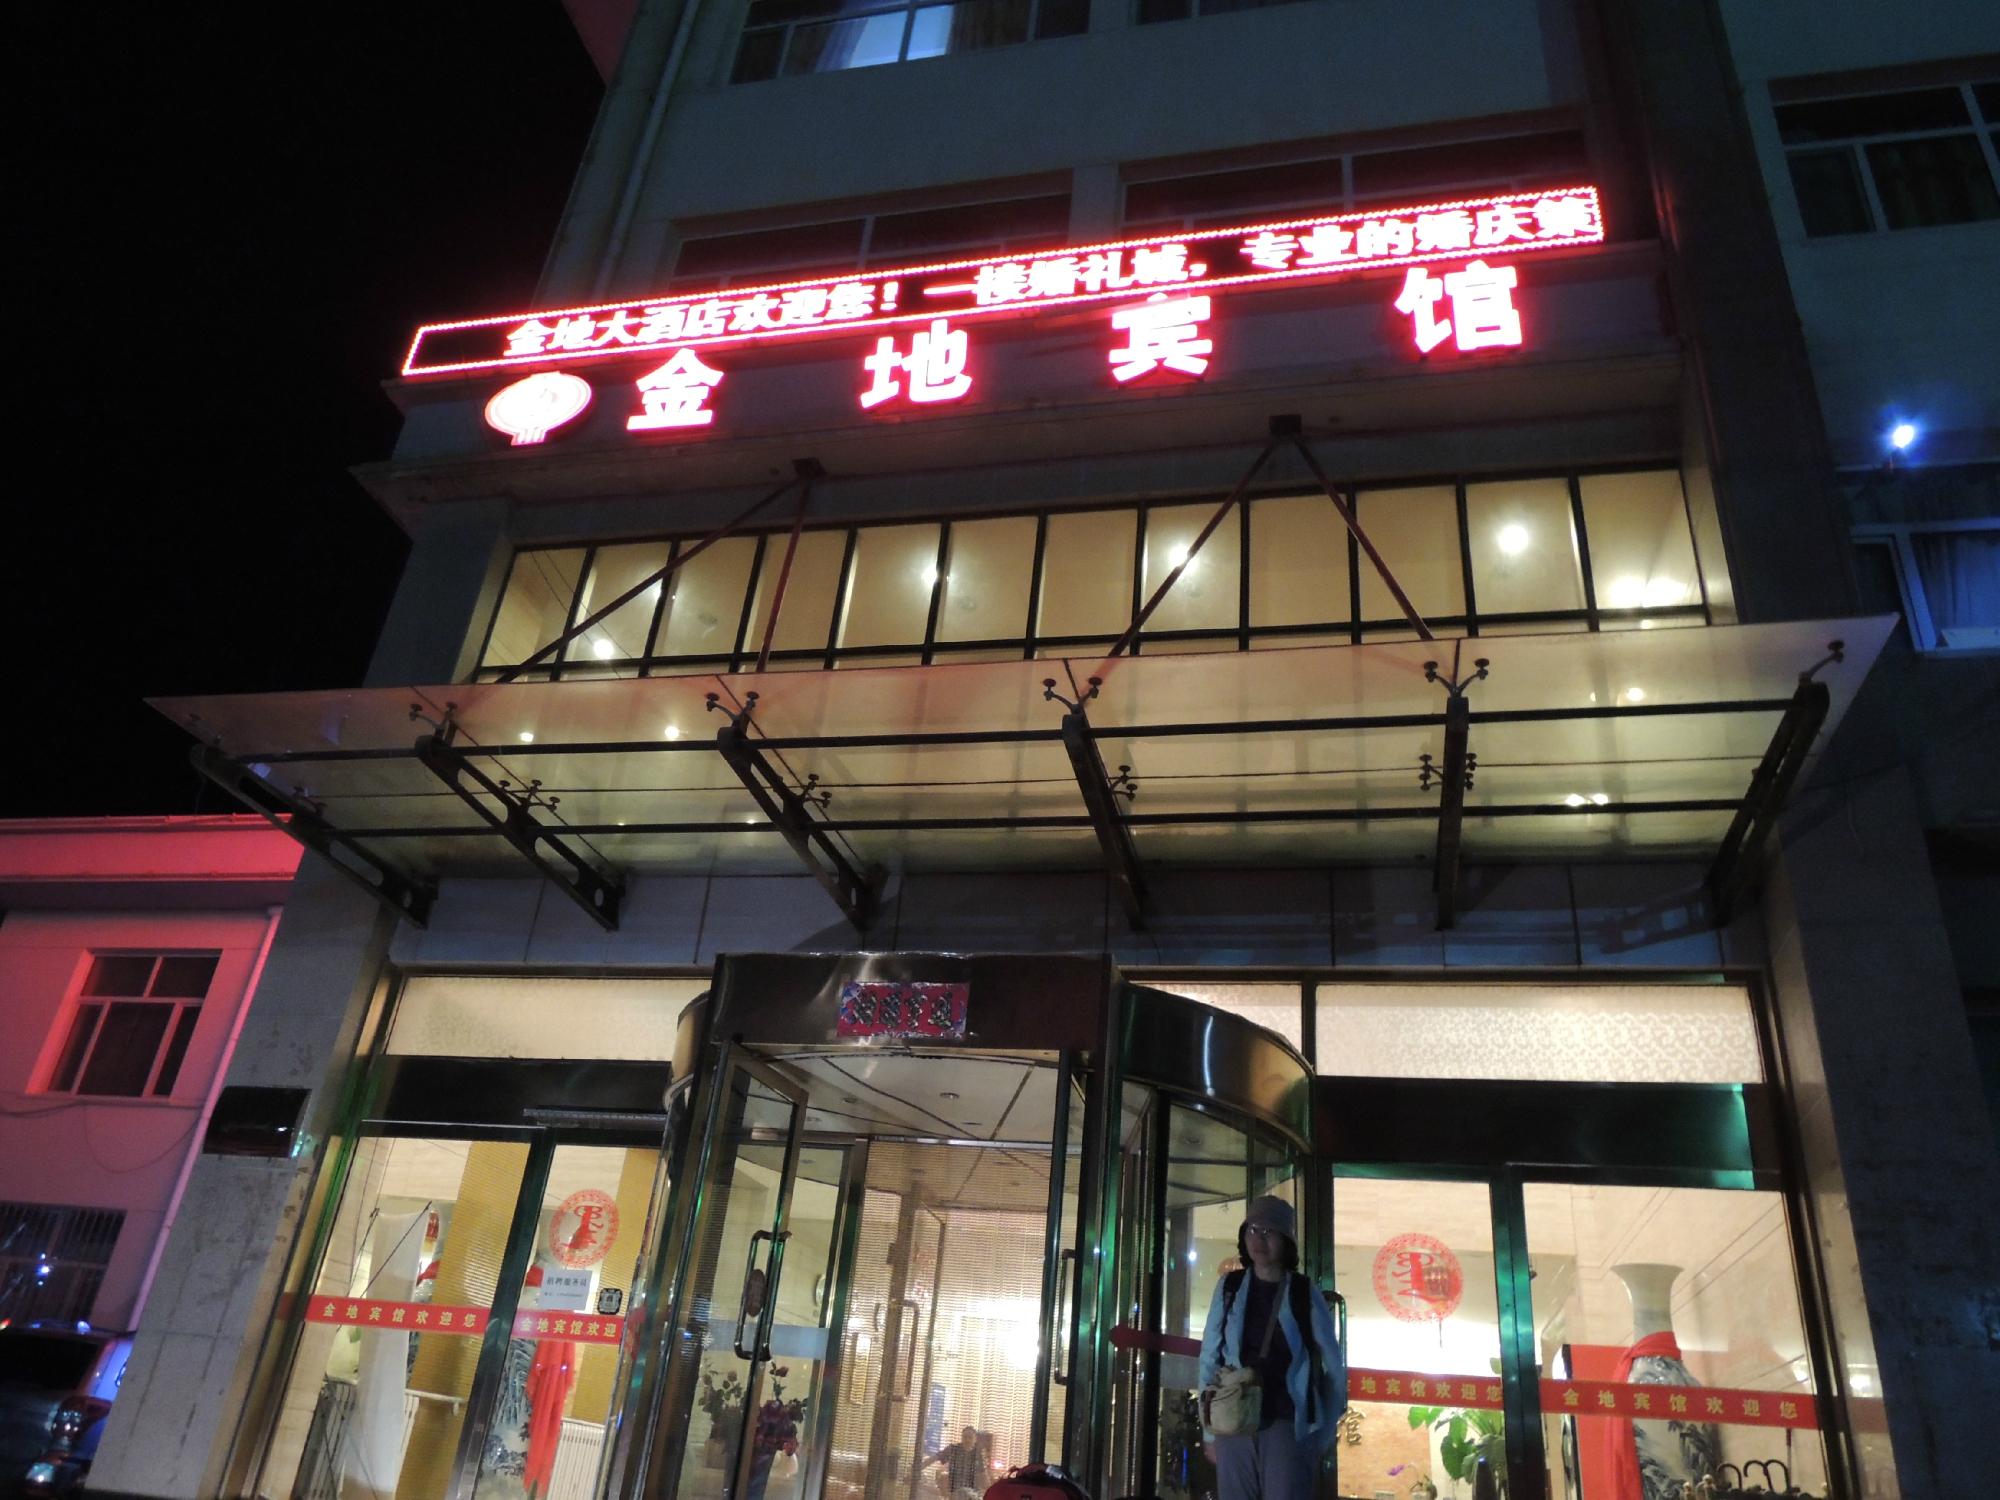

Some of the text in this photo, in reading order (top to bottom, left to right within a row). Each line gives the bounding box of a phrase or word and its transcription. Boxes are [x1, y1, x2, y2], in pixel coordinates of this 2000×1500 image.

[626, 261, 1523, 431] 金地宾馆
[323, 1303, 477, 1328] 金地宾馆欢迎您
[520, 1316, 615, 1337] 金地宾馆欢迎
[1347, 1376, 1503, 1402] 地宾馆欢迎您
[1563, 1388, 1798, 1418] 金地宾馆欢迎您
